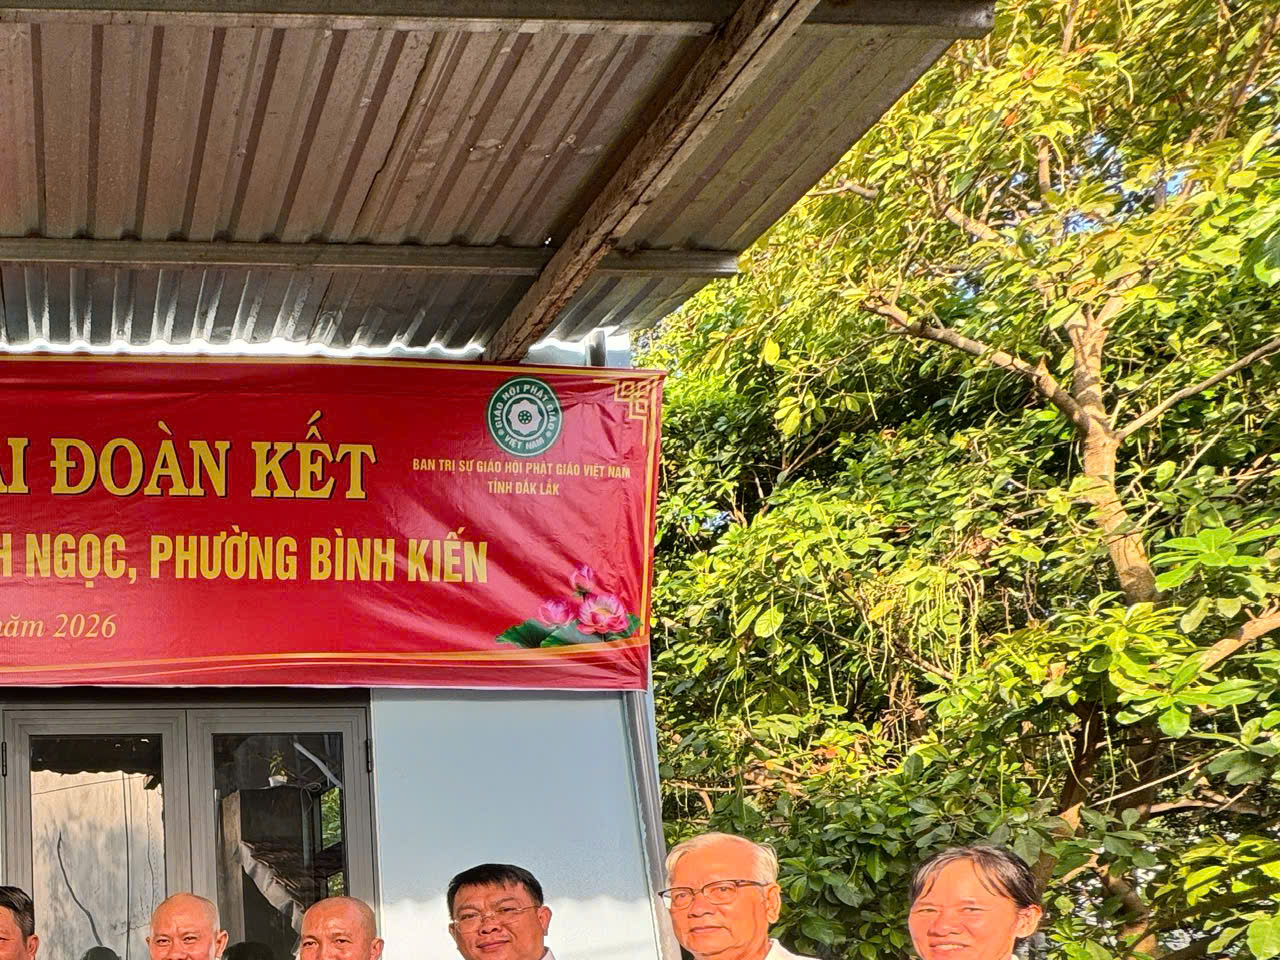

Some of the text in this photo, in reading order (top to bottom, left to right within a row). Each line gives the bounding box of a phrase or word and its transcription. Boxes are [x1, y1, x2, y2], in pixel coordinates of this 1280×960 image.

[50, 420, 227, 497] ĐOÀN
[251, 409, 376, 499] KẾT
[526, 437, 544, 450] NAM
[412, 458, 436, 471] BAN
[439, 459, 455, 474] TRỊ
[476, 459, 502, 473] GIÁO
[556, 462, 580, 476] GIÁO
[583, 463, 604, 480] VIỆT
[608, 466, 630, 479] NAM
[26, 534, 138, 588] NGỌC,
[150, 524, 298, 580] PHƯỜNG
[310, 528, 396, 582] BÌNH
[407, 527, 488, 584] KIẾN
[54, 614, 118, 638] 2026
